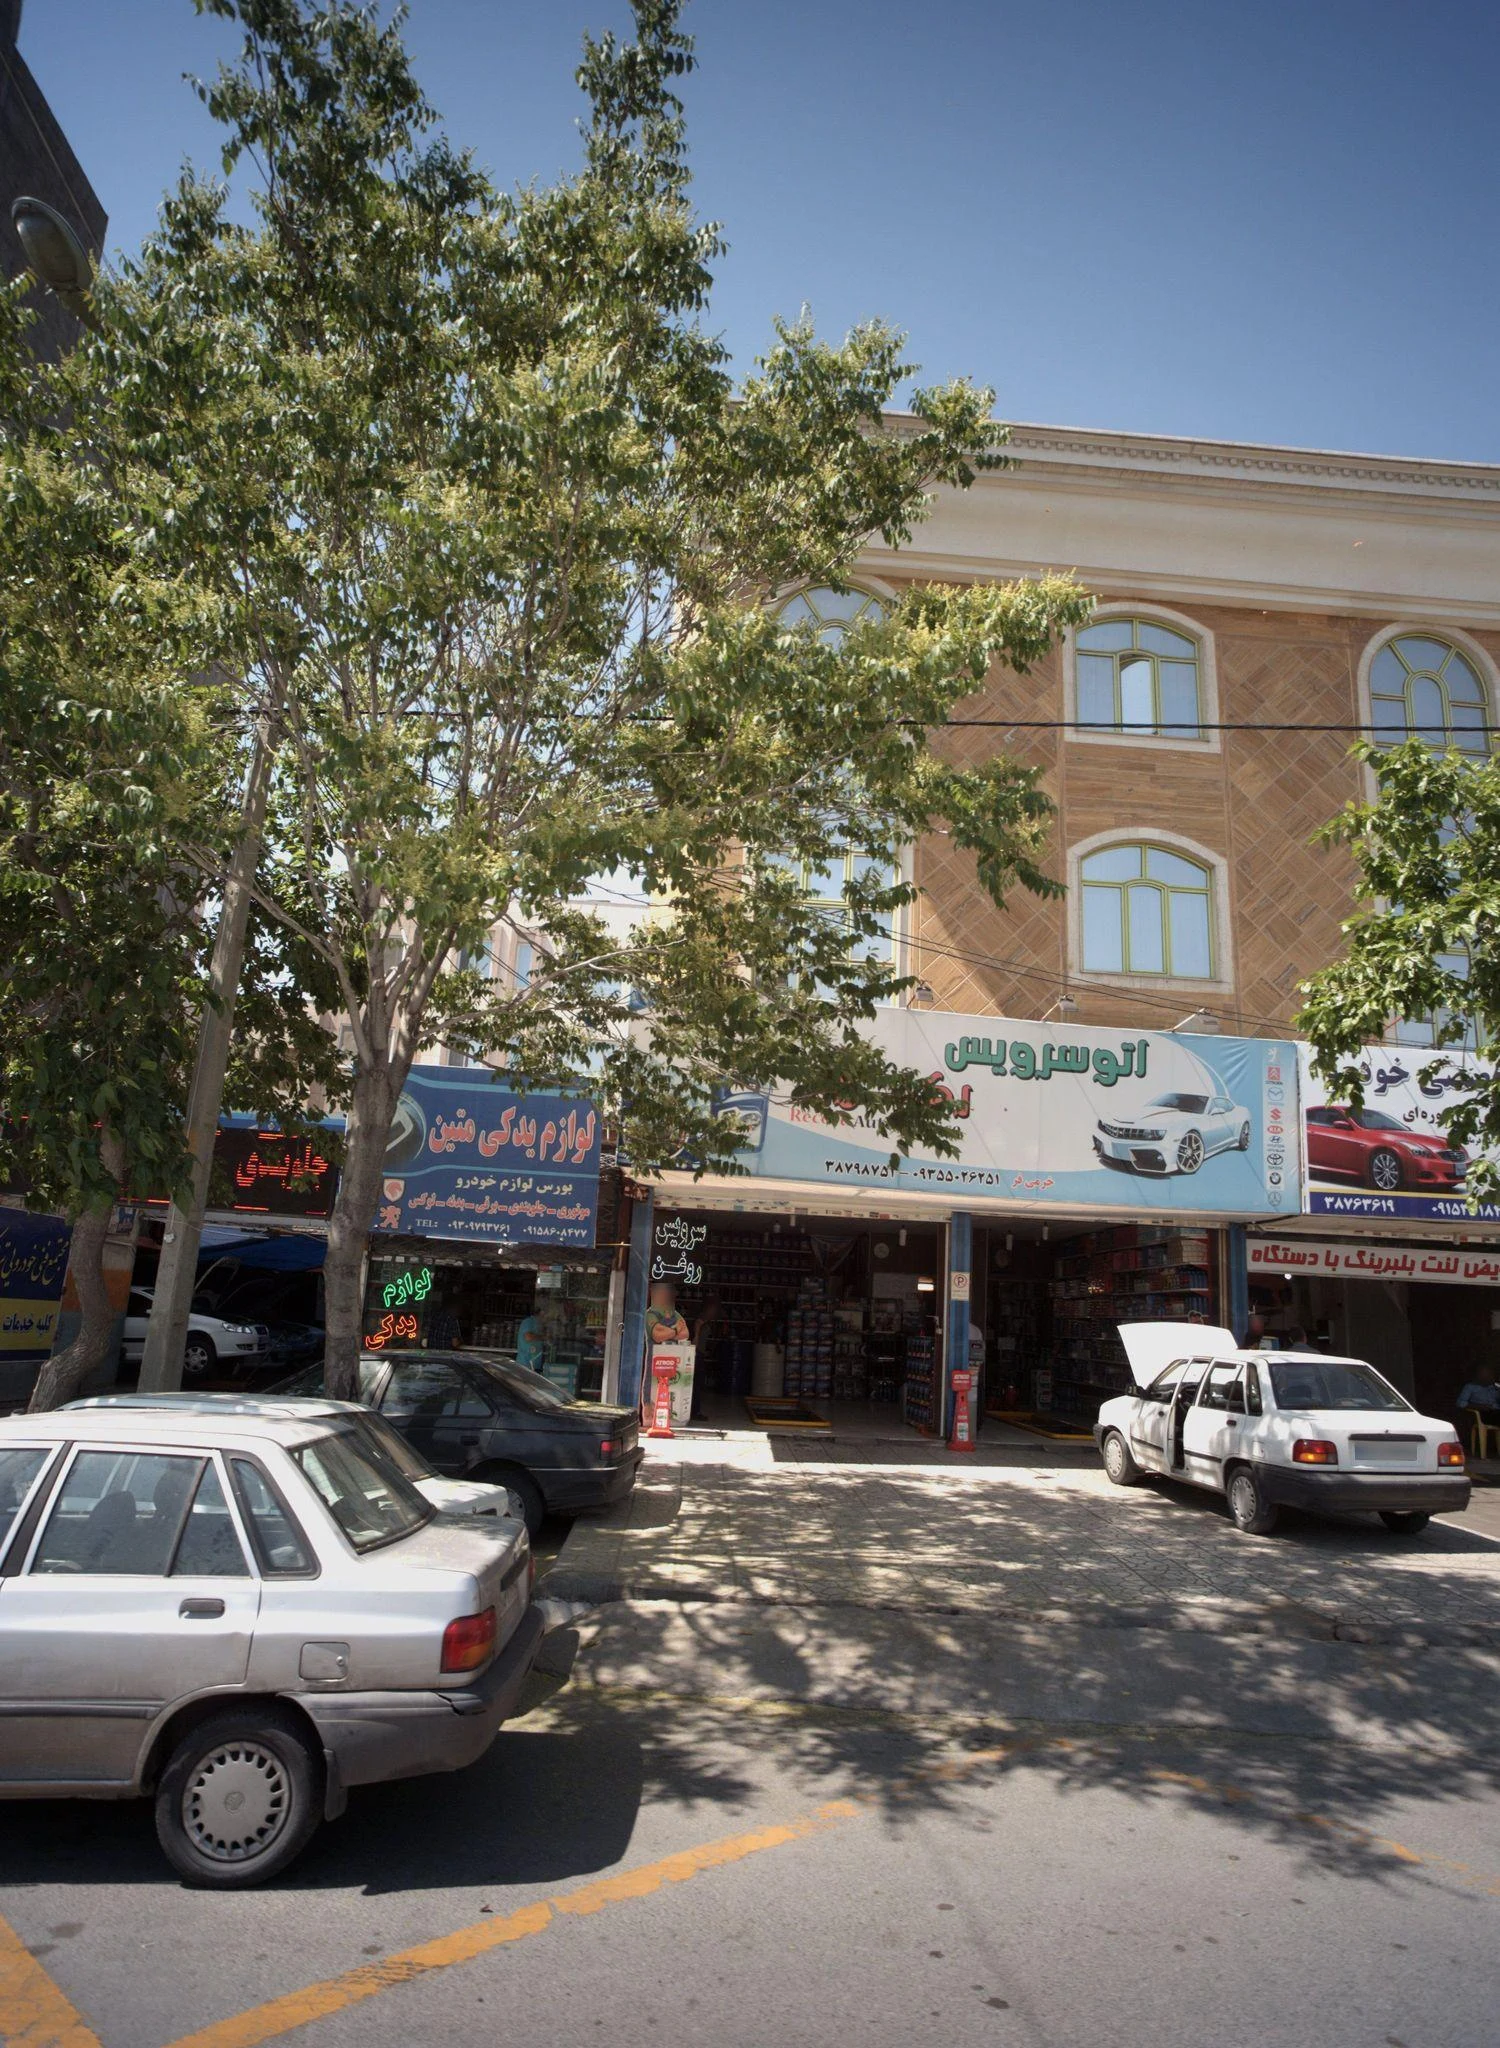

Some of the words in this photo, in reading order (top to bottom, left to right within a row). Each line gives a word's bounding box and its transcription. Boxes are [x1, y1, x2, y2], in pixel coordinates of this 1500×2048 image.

[428, 1108, 476, 1154] متین
[478, 1106, 537, 1158] یدکی
[540, 1109, 596, 1163] لوازم
[455, 1174, 497, 1190] خودرو
[500, 1177, 533, 1192] لوازم
[536, 1181, 573, 1196] بورس
[1324, 1196, 1395, 1213] ۳۸۷۶۳۶۱۹
[416, 1218, 438, 1228] TEL:
[655, 1216, 707, 1250] سرویس
[1251, 1245, 1318, 1266] دستگاه
[1324, 1249, 1339, 1271] با
[1344, 1250, 1416, 1276] بلبرینگ
[1420, 1255, 1459, 1274] لنت
[651, 1251, 702, 1285] روغن
[383, 1267, 432, 1308] لوازم
[366, 1313, 417, 1350] یدکی
